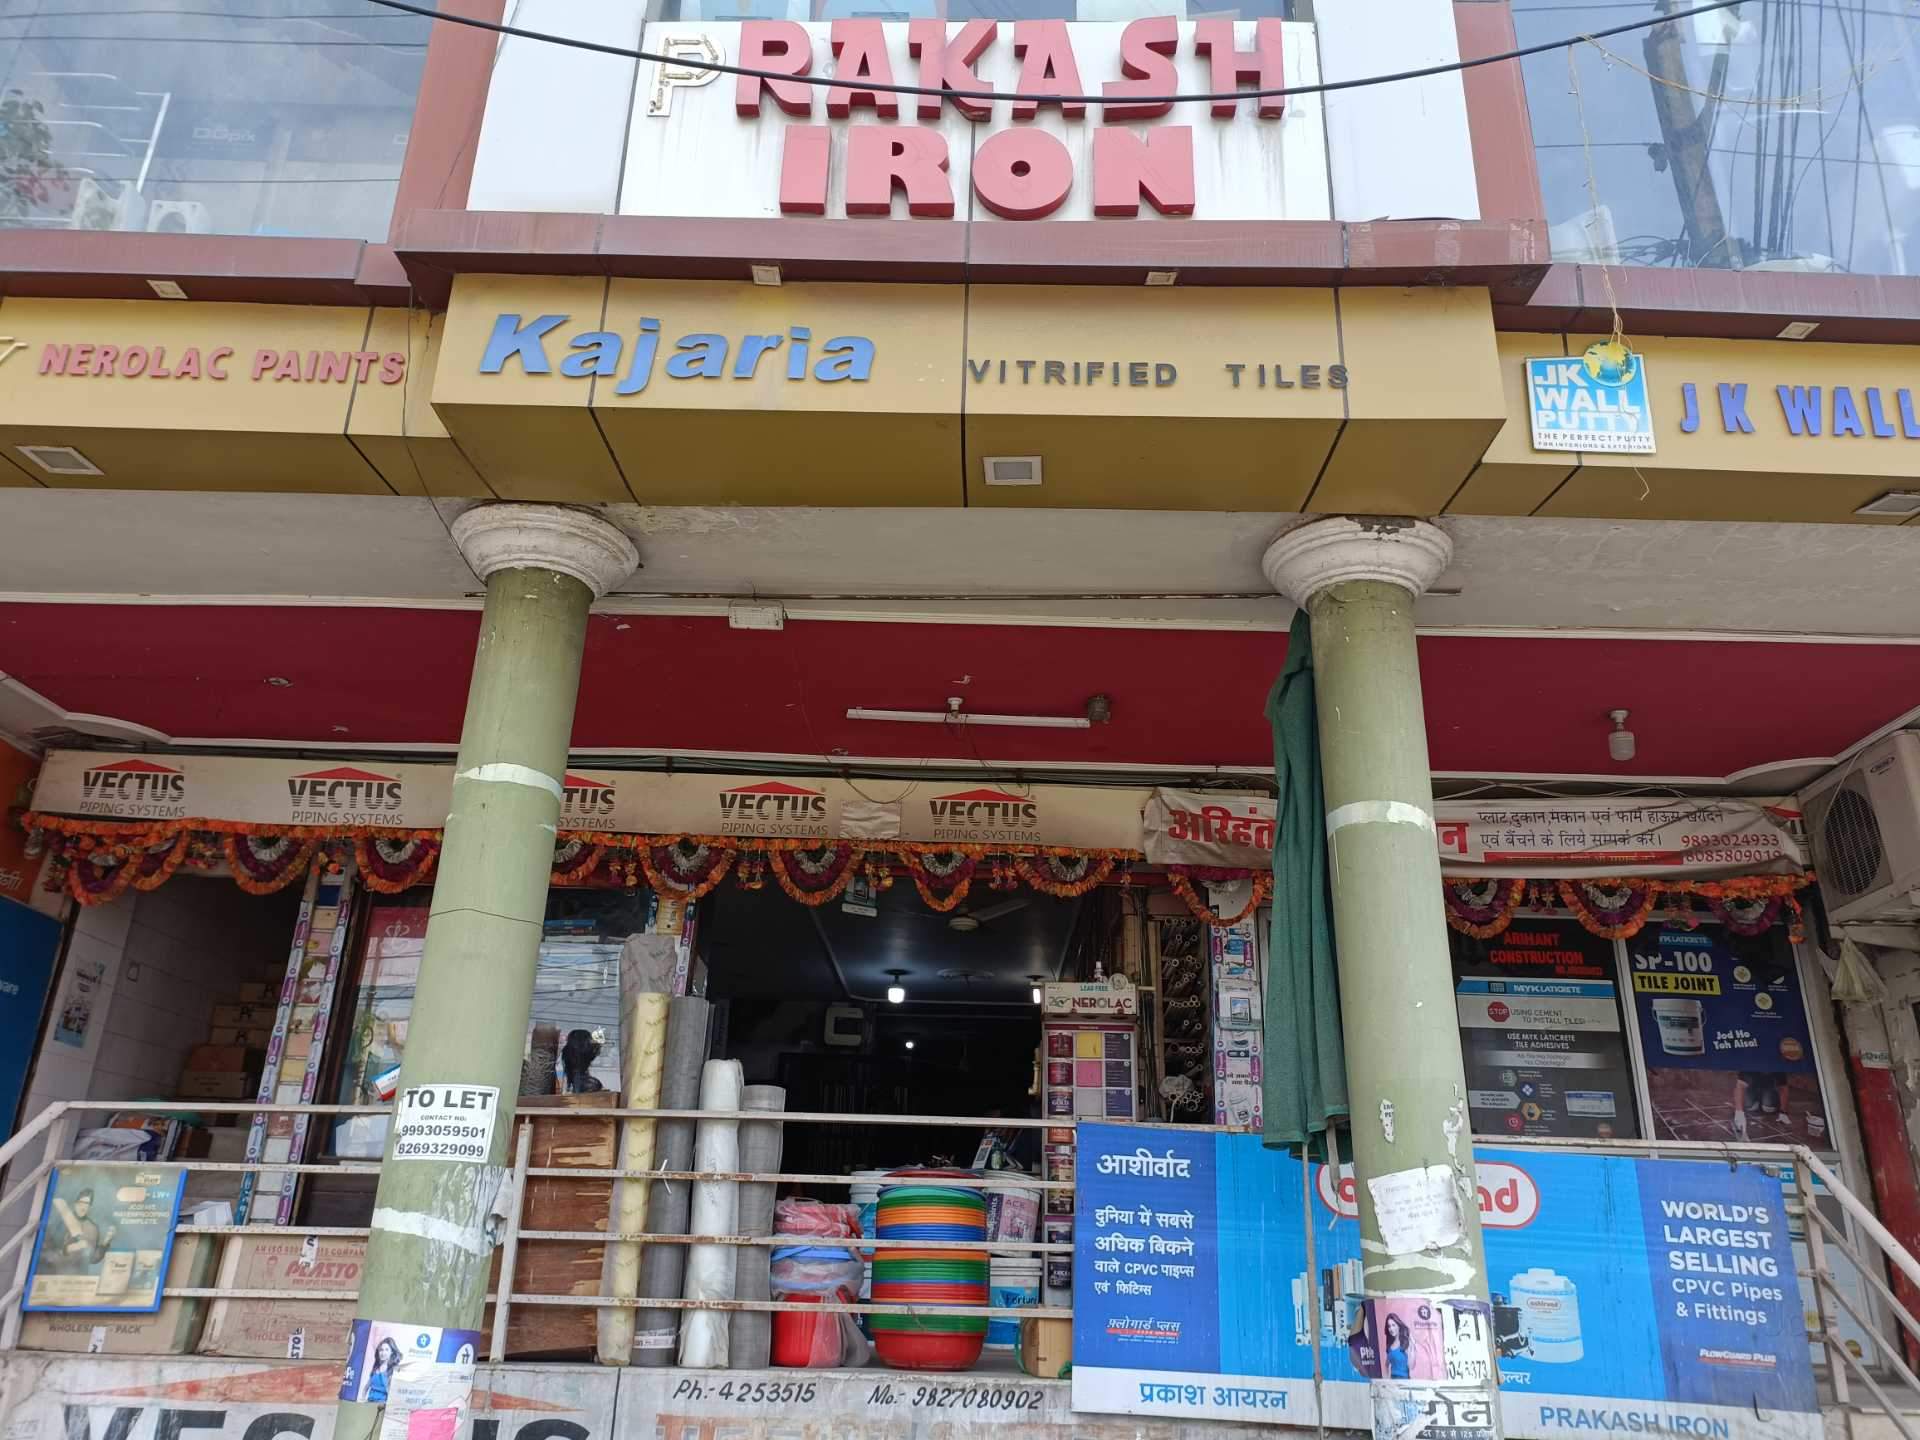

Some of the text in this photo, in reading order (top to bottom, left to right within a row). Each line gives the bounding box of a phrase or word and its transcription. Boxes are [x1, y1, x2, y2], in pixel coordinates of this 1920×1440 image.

[647, 17, 1286, 122] PRAKASH
[779, 125, 1195, 220] IRON
[40, 343, 406, 385] NEROLAC PAINTS
[479, 313, 876, 395] Kajaria
[969, 358, 1351, 390] VITRIFIED TILES
[1535, 363, 1588, 388] JK
[1537, 387, 1641, 413] WALL
[1776, 384, 1920, 439] WALL
[1537, 411, 1641, 433] PUTTY
[1538, 432, 1559, 441] THE
[1562, 434, 1613, 442] PERFECT
[82, 770, 185, 804] VECTUS
[288, 778, 403, 811] VECTUS
[80, 800, 186, 819] PIPING SYSTEMS
[291, 810, 404, 827] PIPING SYSTEMS
[719, 792, 827, 822] VECTUS
[929, 799, 1038, 829] VECTUS
[1591, 807, 1610, 824] एवं
[558, 817, 616, 830] SYSTEMS
[721, 821, 829, 837] PIPING SYSTEMS
[933, 827, 1042, 843] PIPING SYSTEMS
[1480, 830, 1500, 848] एवं
[1680, 833, 1780, 848] 9893024933
[1489, 949, 1584, 965] CONSTRUCTION
[1638, 975, 1669, 990] TILE
[1673, 977, 1715, 992] JOINT
[1072, 997, 1133, 1009] NEROLAC
[1488, 1007, 1508, 1016] STOP
[1735, 1029, 1751, 1039] Ho
[405, 1089, 493, 1110] TO LET
[420, 1114, 452, 1122] CONTACT
[401, 1124, 486, 1139] 9993059501
[398, 1142, 484, 1157] 8269329099
[1096, 1147, 1191, 1179] आशीर्वाद
[1095, 1205, 1195, 1230] दुनिया में सबसे
[1661, 1199, 1769, 1224] WORLD'S
[1095, 1233, 1194, 1256] अधिक बिकने
[1664, 1225, 1773, 1251] LARGEST
[284, 1260, 359, 1280] PLASTO
[1094, 1258, 1195, 1278] वाले CPVC पाइप्स
[1669, 1250, 1779, 1278] SELLING
[1094, 1279, 1108, 1296] एवं
[1672, 1277, 1783, 1302] CPVC Pipes
[1676, 1302, 1768, 1326] & Fittings
[912, 1386, 1045, 1410] 9827080902
[1139, 1381, 1288, 1409] प्रकाश आयरन
[1539, 1406, 1729, 1440] PRAKASH IRON
